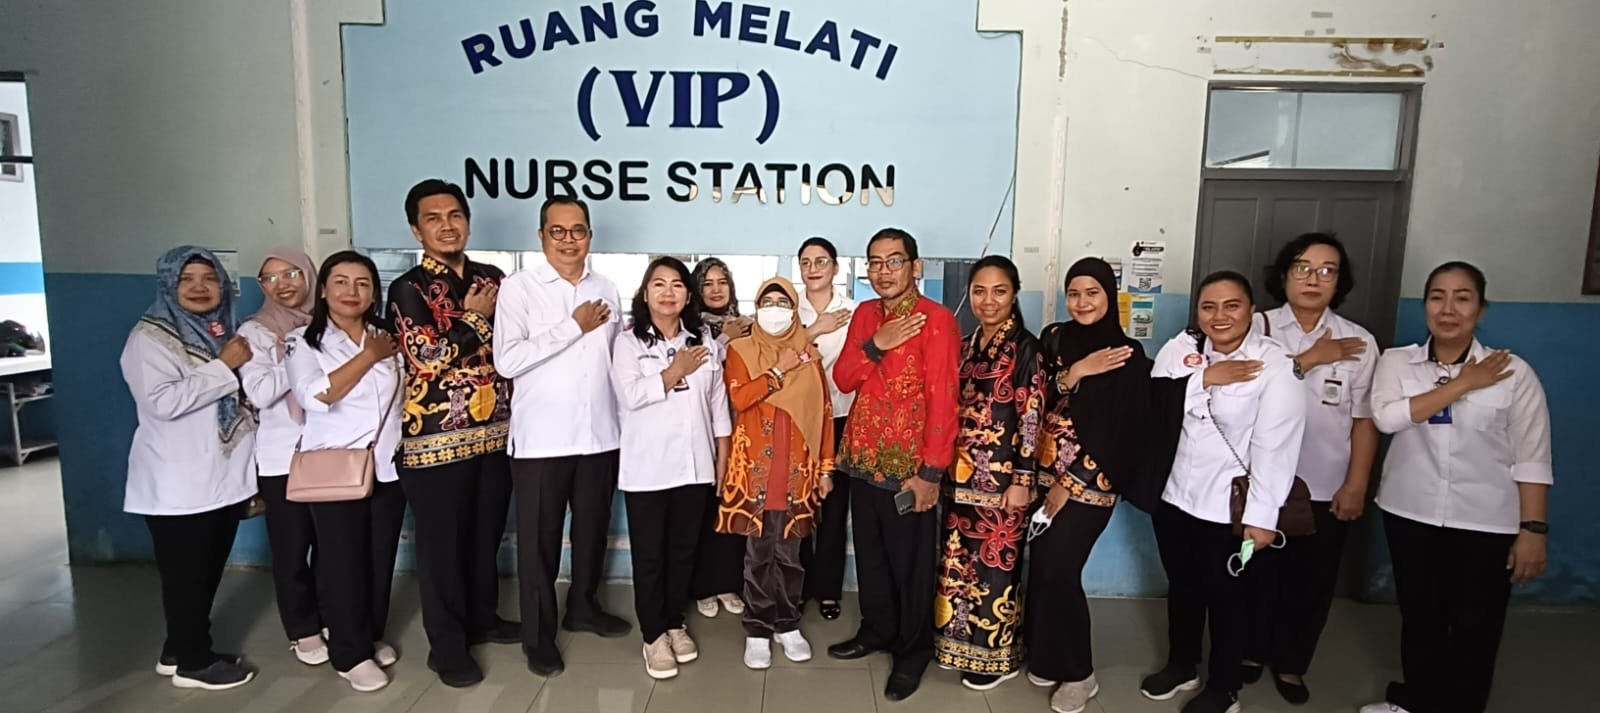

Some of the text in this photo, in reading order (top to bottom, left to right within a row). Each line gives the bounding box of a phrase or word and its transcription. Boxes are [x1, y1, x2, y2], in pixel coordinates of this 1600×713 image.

[461, 0, 898, 80] RUANG MELATI
[577, 66, 780, 145] (VIP)
[465, 157, 895, 206] NURSE STATION
